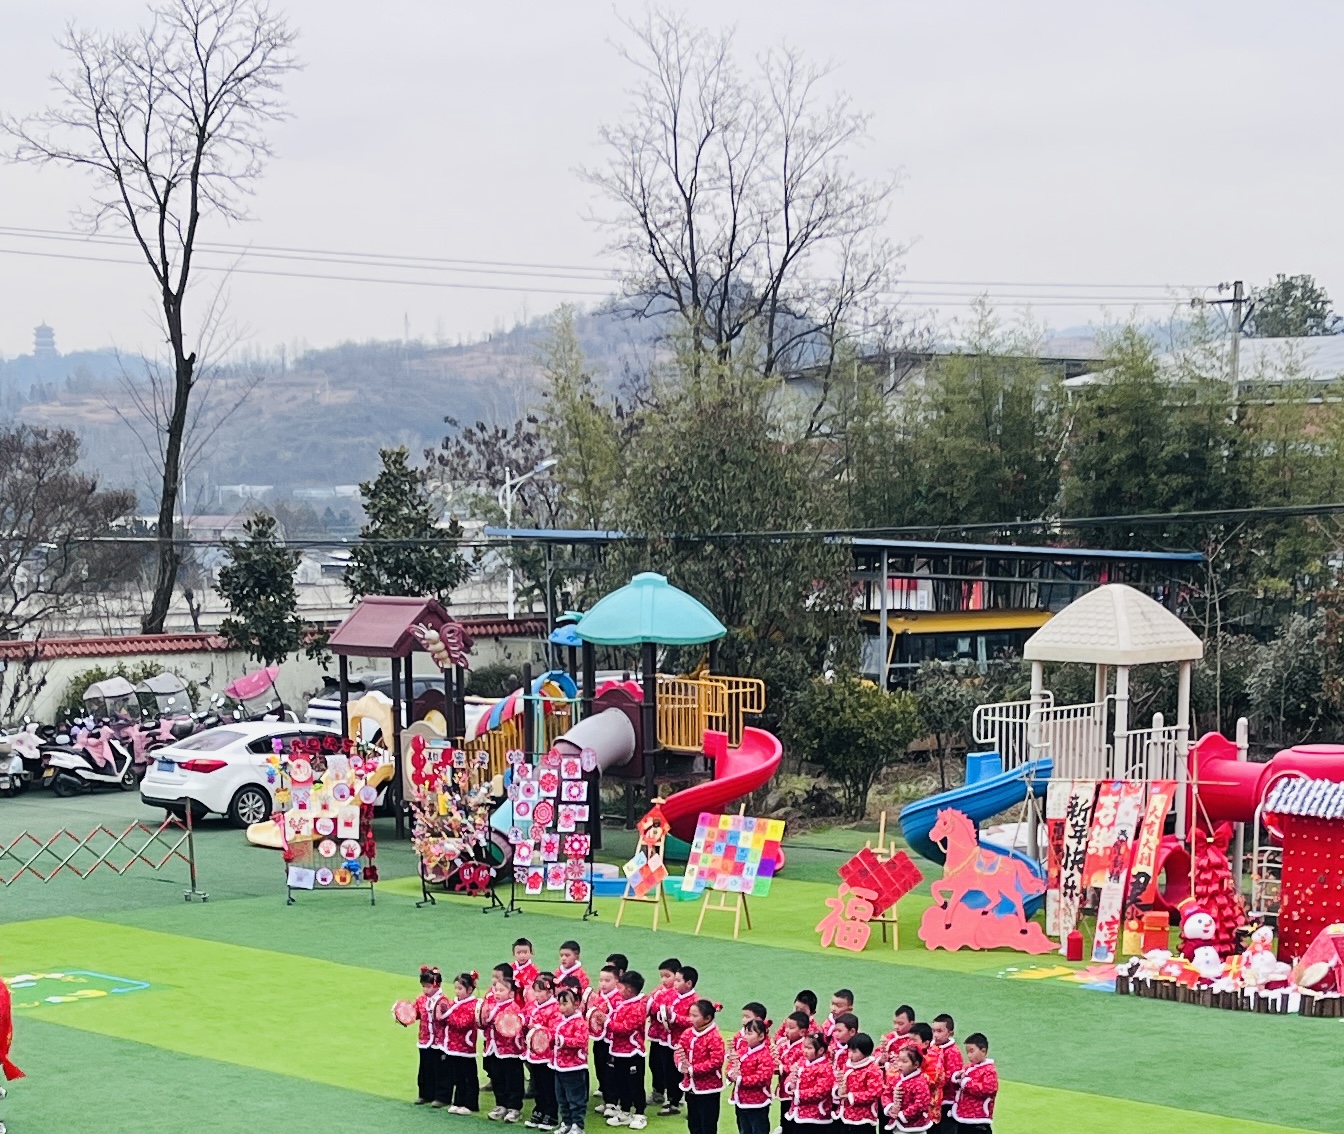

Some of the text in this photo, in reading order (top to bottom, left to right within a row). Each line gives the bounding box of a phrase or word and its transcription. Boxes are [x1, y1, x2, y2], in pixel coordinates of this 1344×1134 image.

[1063, 793, 1092, 899] 新年快乐
[1139, 805, 1160, 867] 大吉大利
[815, 883, 879, 952] 福
